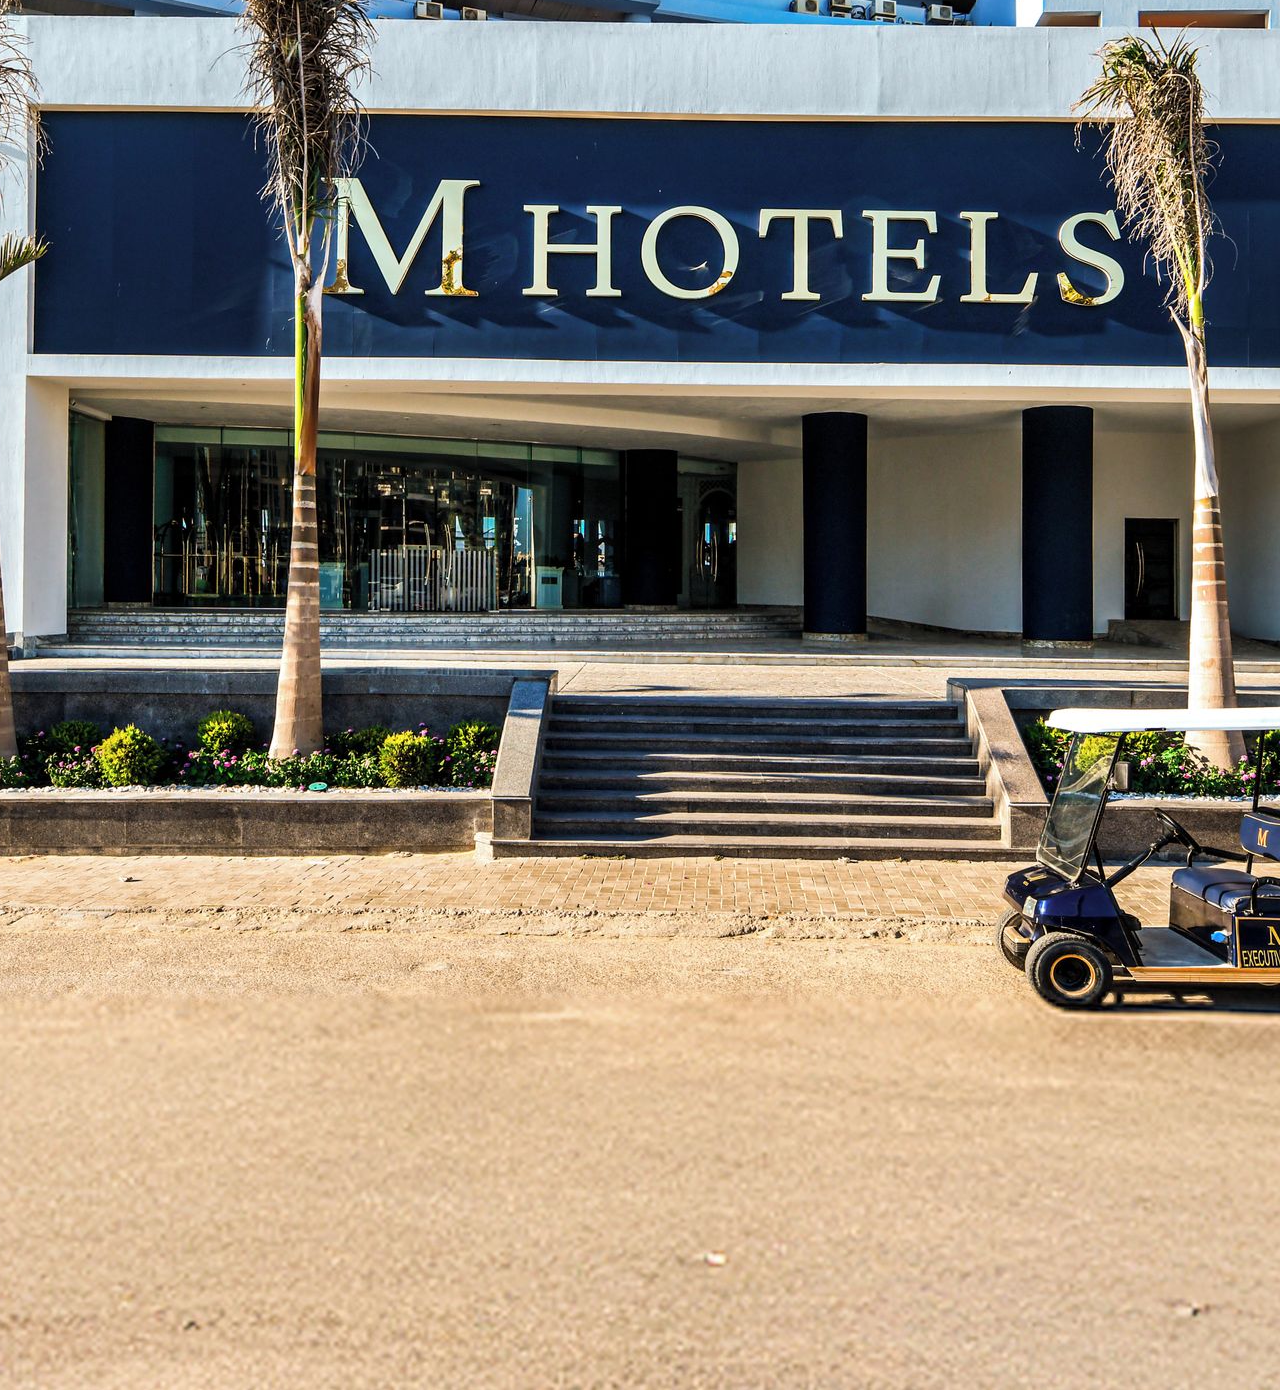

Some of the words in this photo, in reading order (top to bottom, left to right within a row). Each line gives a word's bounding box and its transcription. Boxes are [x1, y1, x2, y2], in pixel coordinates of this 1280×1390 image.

[322, 177, 480, 296] M
[522, 204, 1126, 306] HOTELS
[1257, 828, 1269, 848] M
